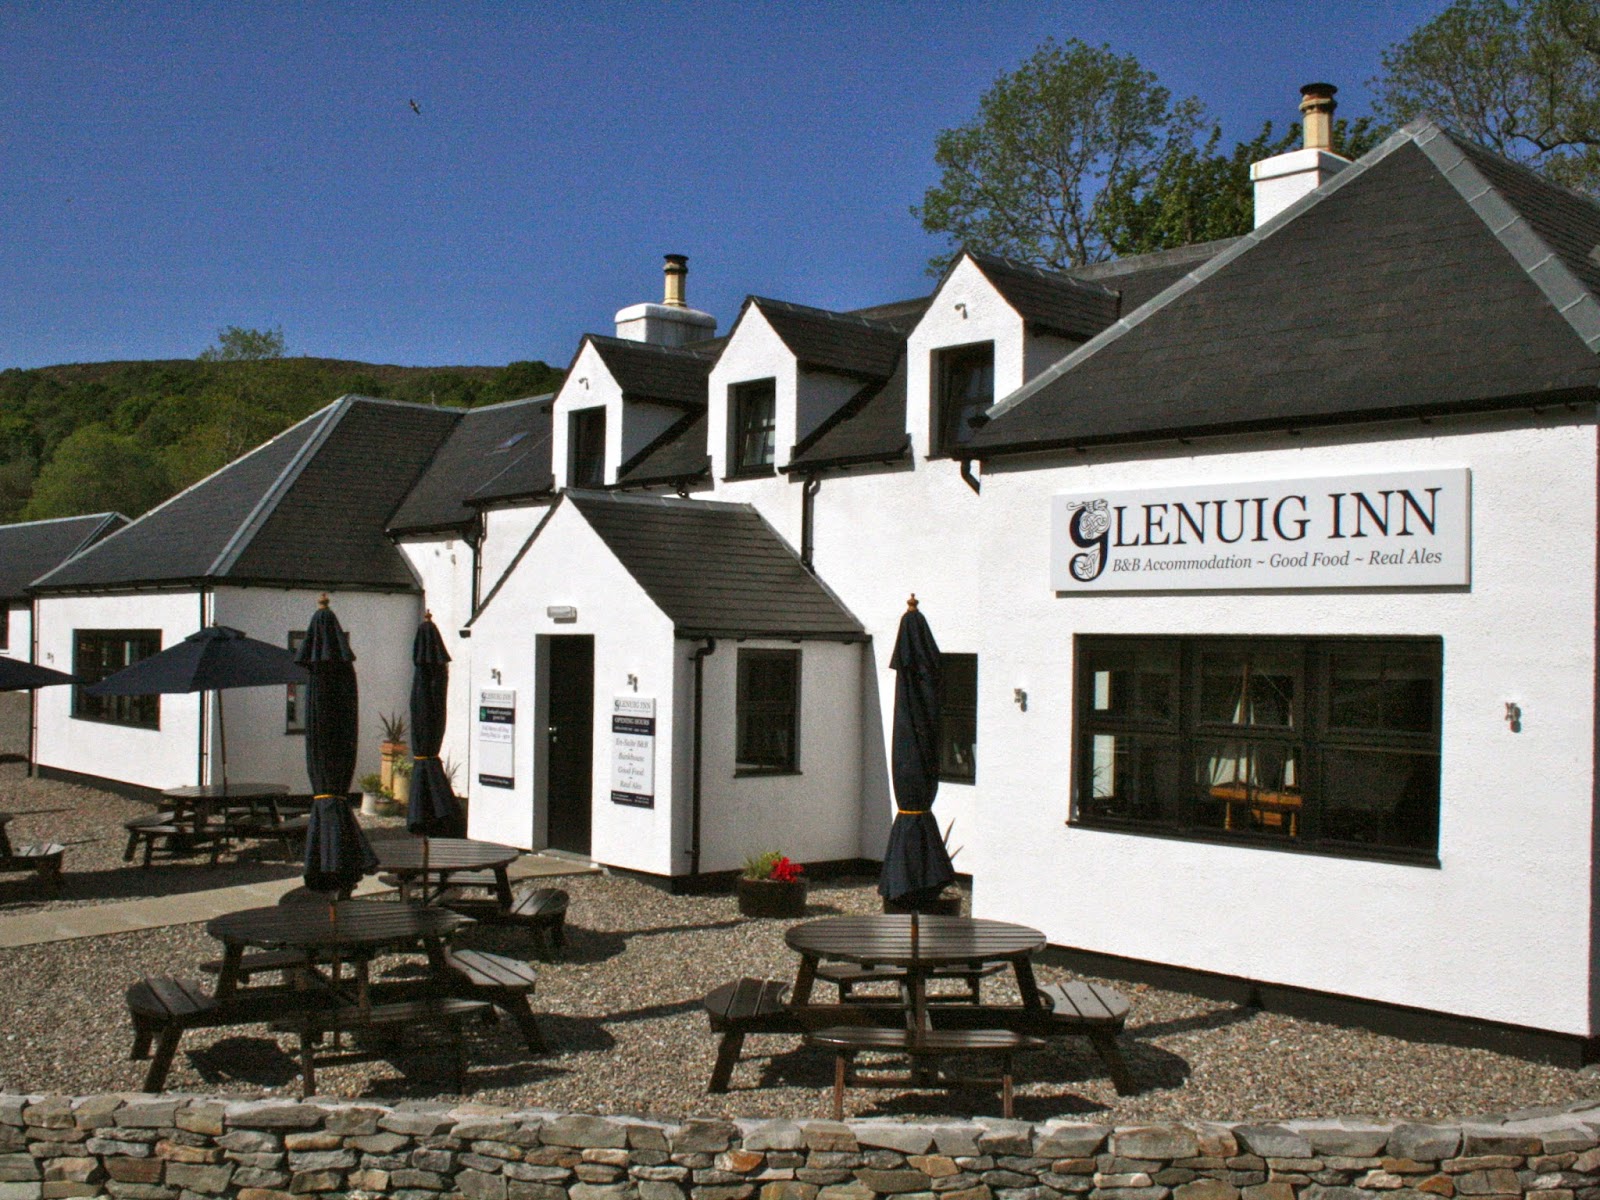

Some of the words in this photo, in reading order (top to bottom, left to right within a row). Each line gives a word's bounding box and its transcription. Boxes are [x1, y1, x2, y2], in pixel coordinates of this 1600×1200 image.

[1327, 487, 1443, 539] INN
[1112, 558, 1141, 572] B&B
[1143, 554, 1252, 571] Accommodation
[1270, 552, 1308, 568] Good
[1310, 551, 1350, 567] Food
[1369, 549, 1405, 565] Real
[1407, 549, 1443, 564] Ales
[618, 767, 631, 775] Good
[631, 768, 644, 776] Food
